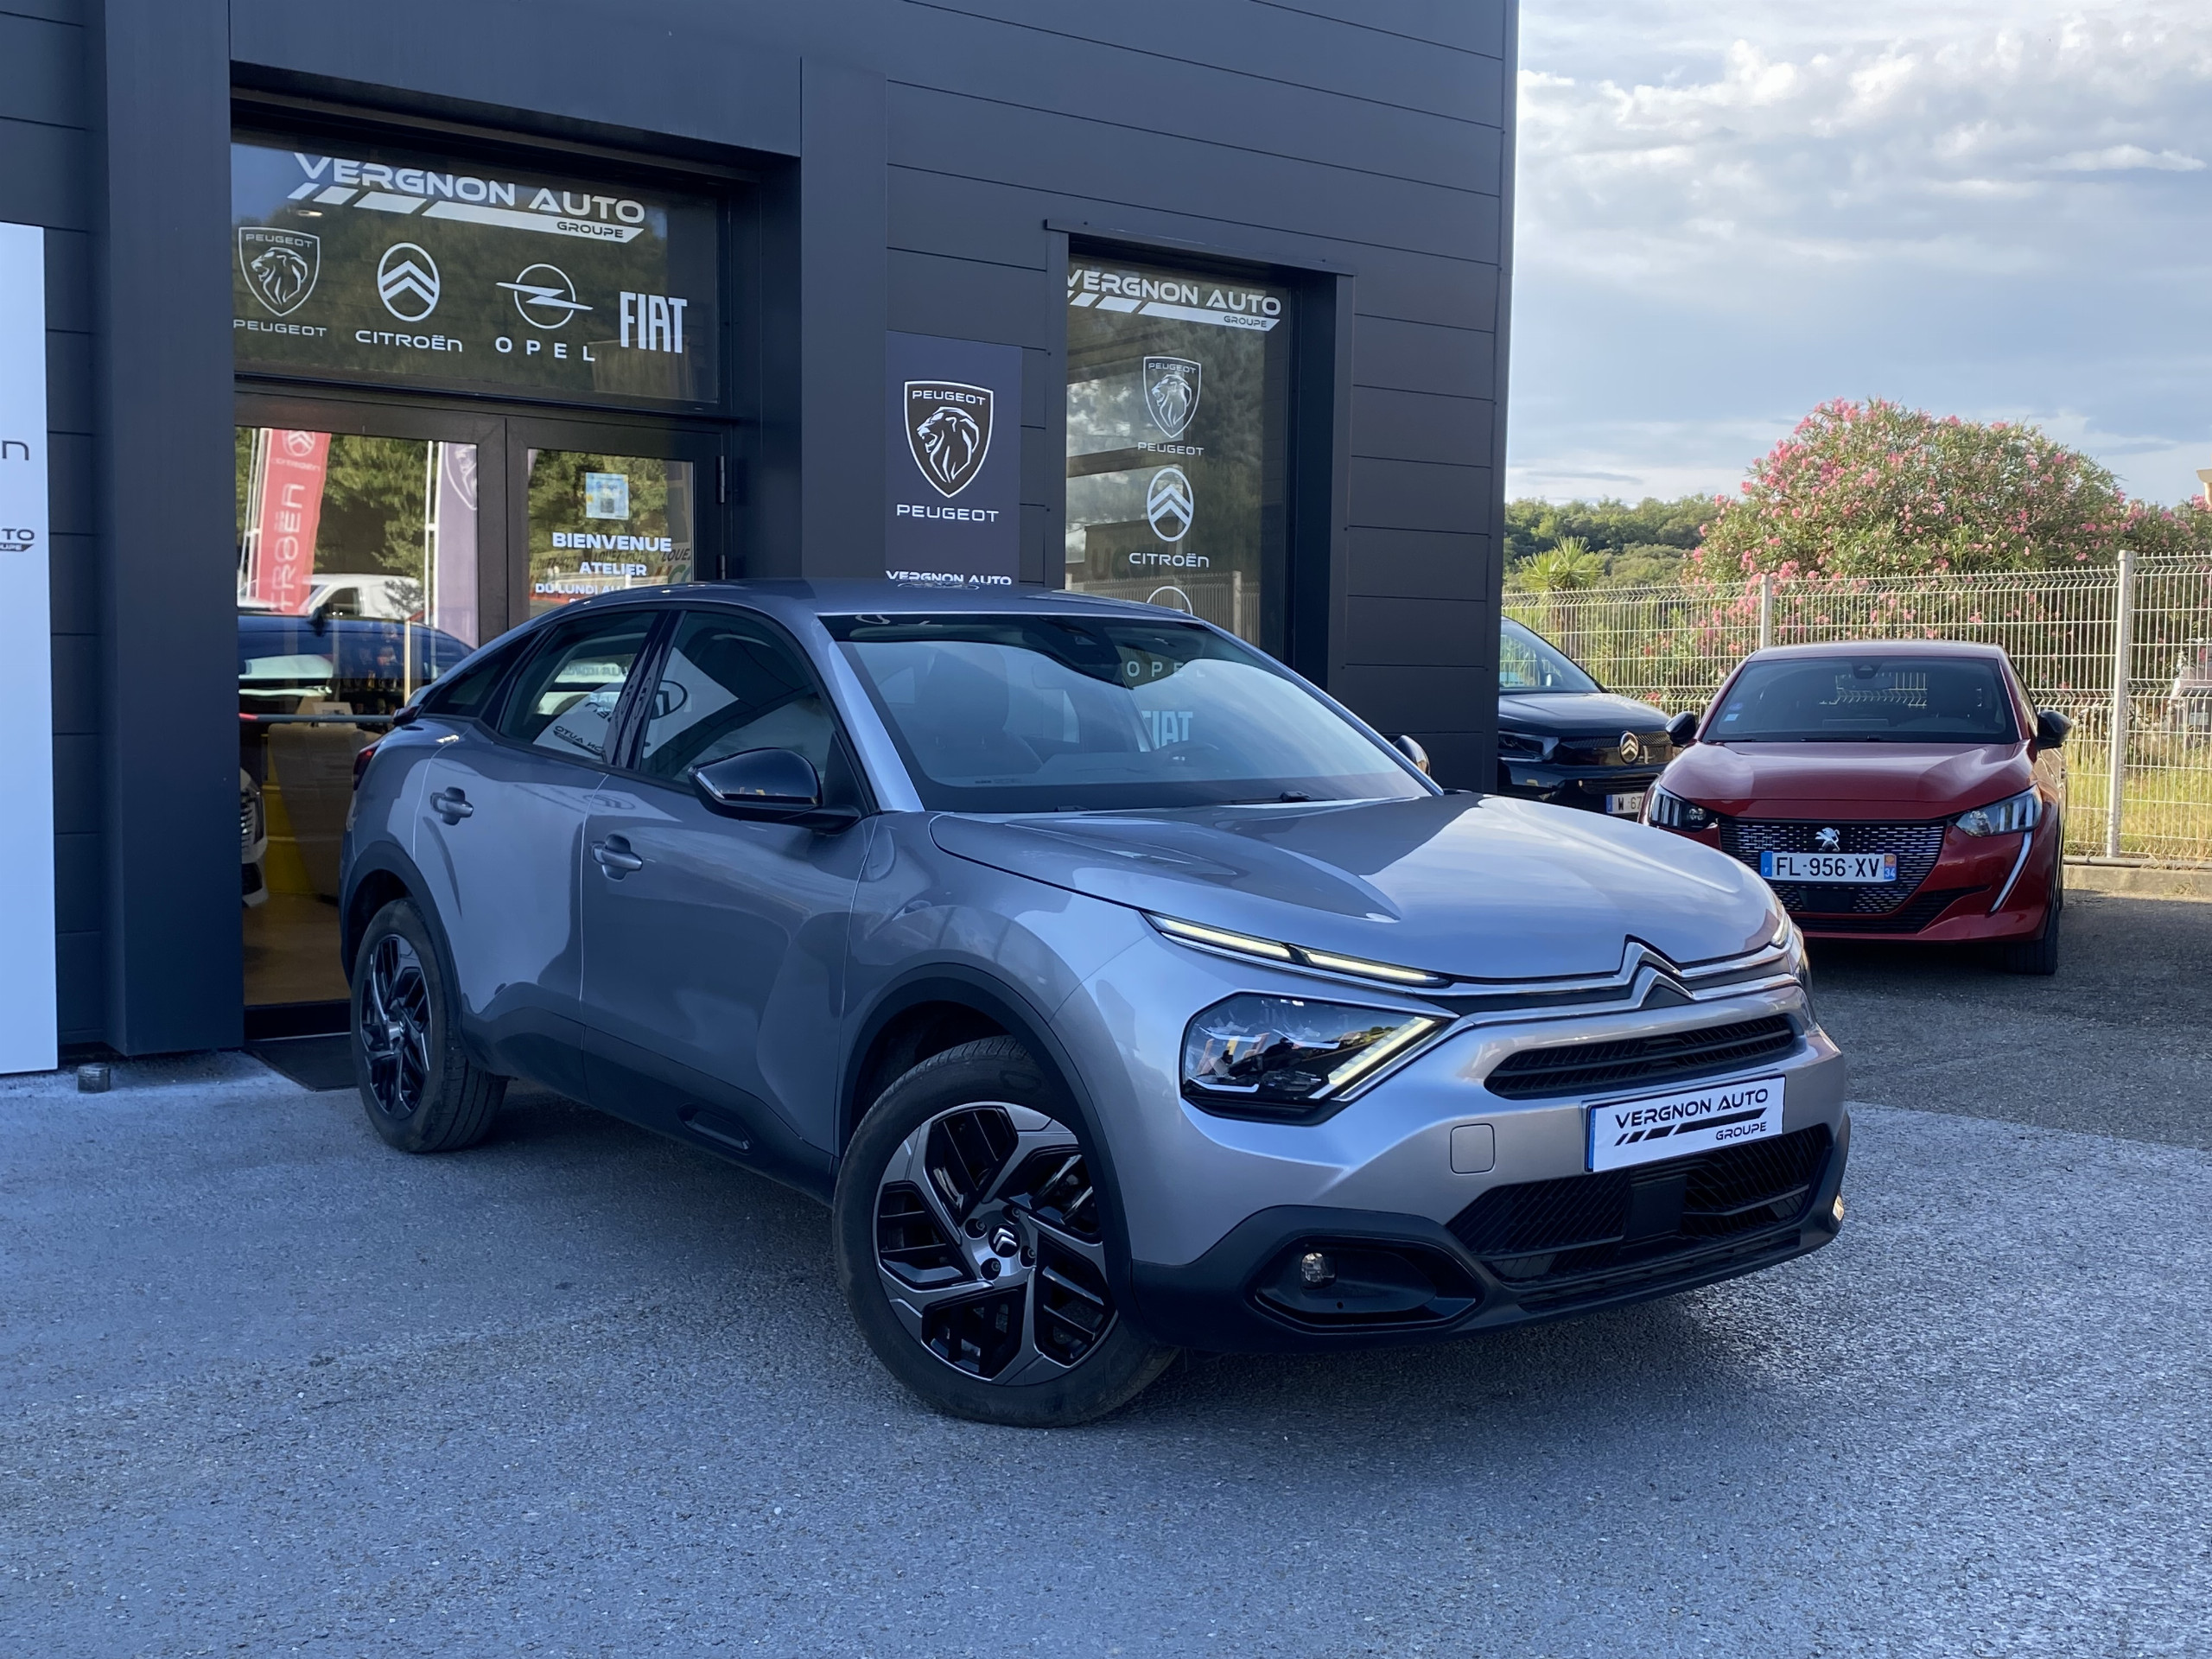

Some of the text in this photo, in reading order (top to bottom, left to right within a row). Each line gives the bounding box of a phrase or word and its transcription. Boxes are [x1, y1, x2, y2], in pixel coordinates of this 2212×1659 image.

[293, 152, 645, 224] VERGNON AUTO
[556, 221, 624, 238] GROUPE
[245, 233, 313, 249] PEUGEOT
[1066, 269, 1282, 316] VERGNON AUTO
[233, 319, 327, 337] PEUGEOT
[620, 291, 688, 353] FIAT
[1223, 315, 1268, 328] GROUPE
[495, 336, 595, 362] OPEL
[1147, 361, 1197, 374] PEUGEOT
[912, 390, 987, 406] PEUGEOT
[1137, 442, 1205, 456] PEUGEOT
[896, 504, 999, 523] PEUGEOT
[2, 528, 35, 541] TO
[552, 532, 672, 552] BIENVENUE
[579, 562, 647, 576] ATELIER
[886, 570, 1012, 586] VERGNON AUTO
[535, 583, 555, 594] DU
[560, 584, 598, 594] LUNDI
[1777, 856, 1879, 878] FL-956-XV
[1885, 868, 1896, 878] 34
[1615, 1088, 1768, 1128] VERGNON AUTO
[1716, 1122, 1767, 1141] GROUPE
